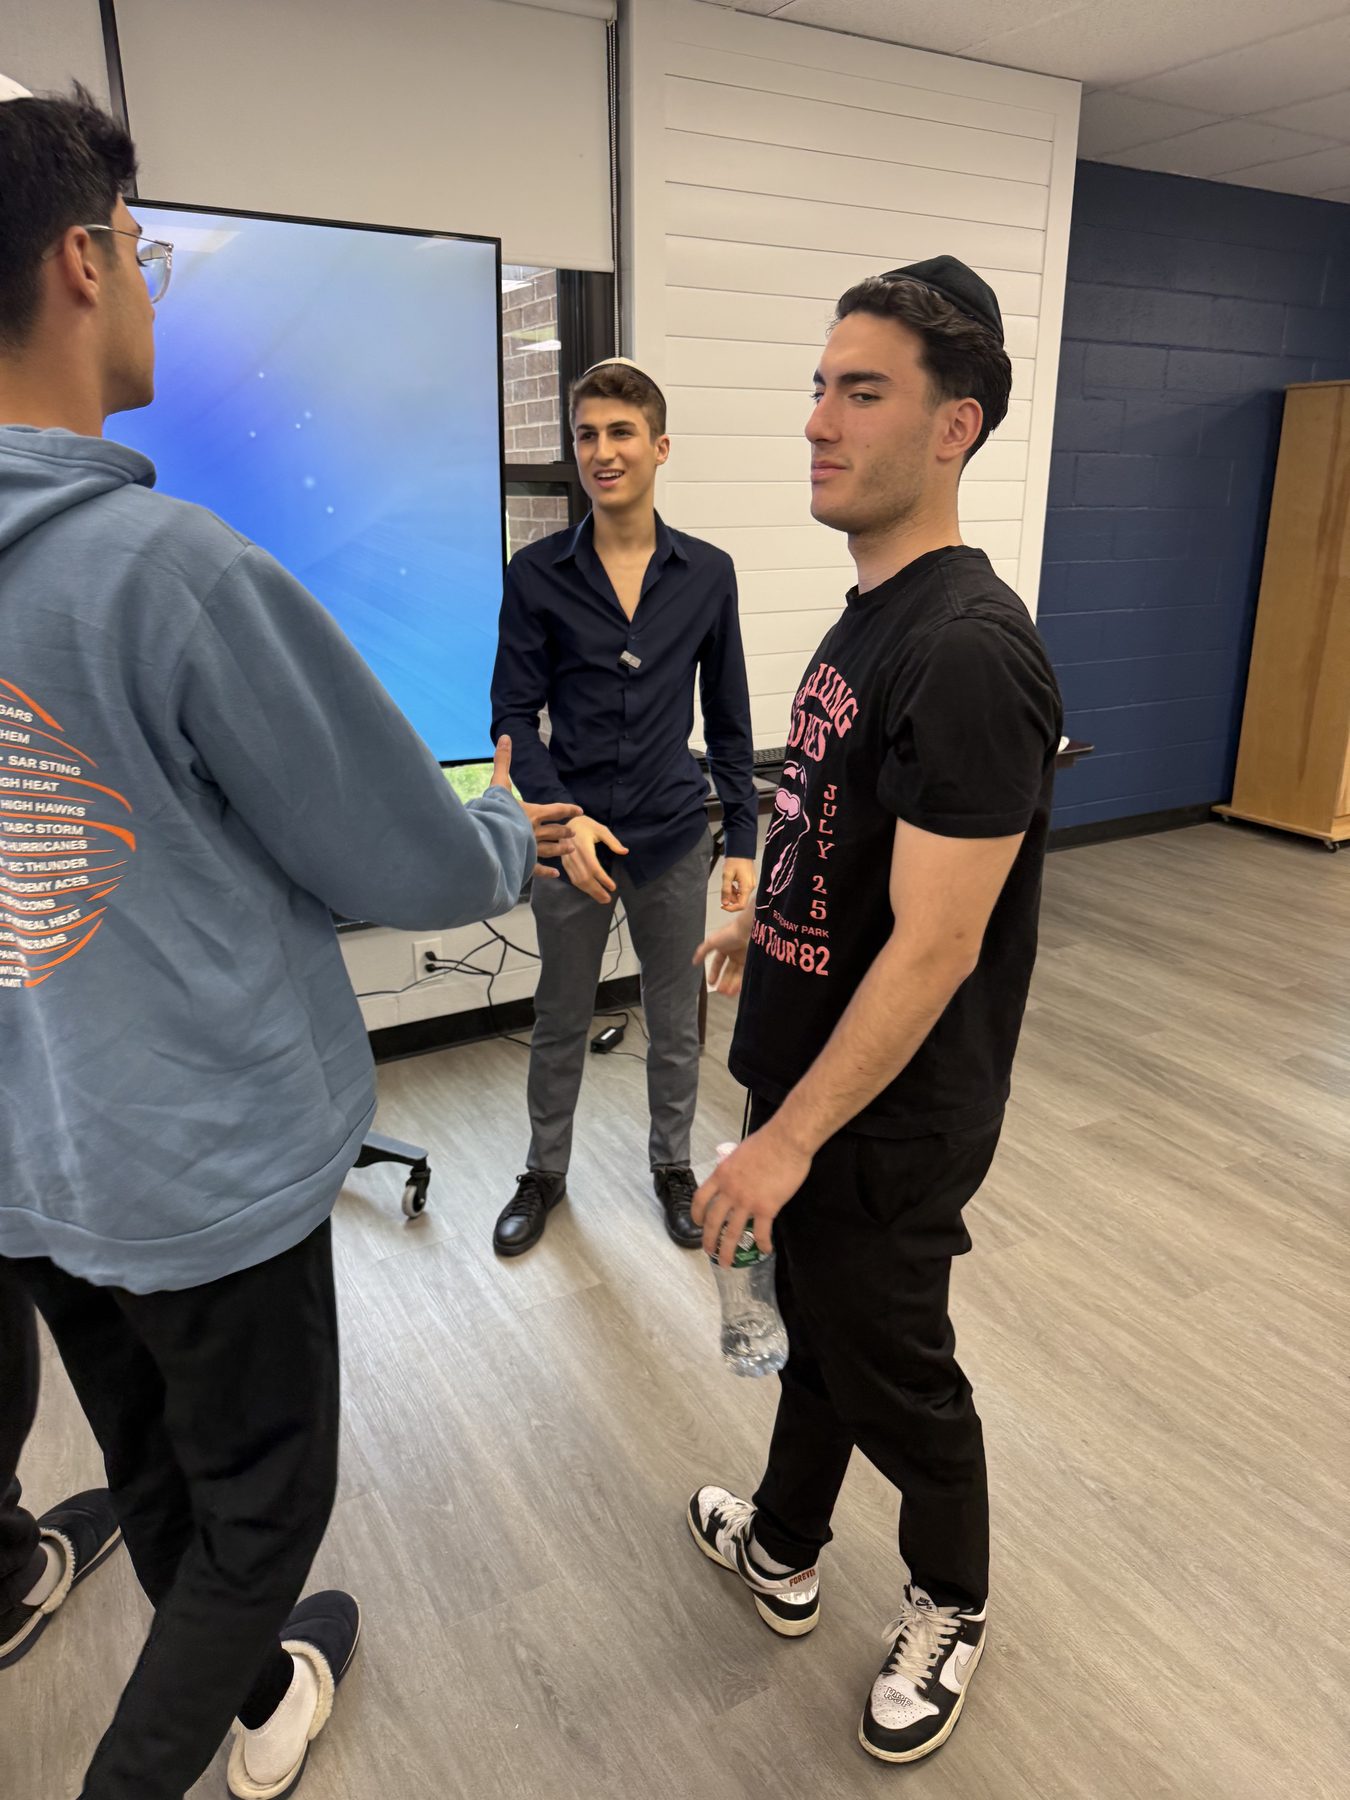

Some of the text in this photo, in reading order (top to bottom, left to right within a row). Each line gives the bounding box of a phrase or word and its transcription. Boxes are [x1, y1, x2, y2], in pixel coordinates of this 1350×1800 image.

[8, 755, 81, 776] SAR STING
[22, 779, 60, 792] HEAT
[35, 802, 86, 817] HAWKS
[36, 823, 84, 836] STORM
[809, 783, 838, 920] JULY 25
[23, 857, 89, 872] THUNDER
[55, 875, 89, 890] ACES
[801, 925, 830, 939] PARK
